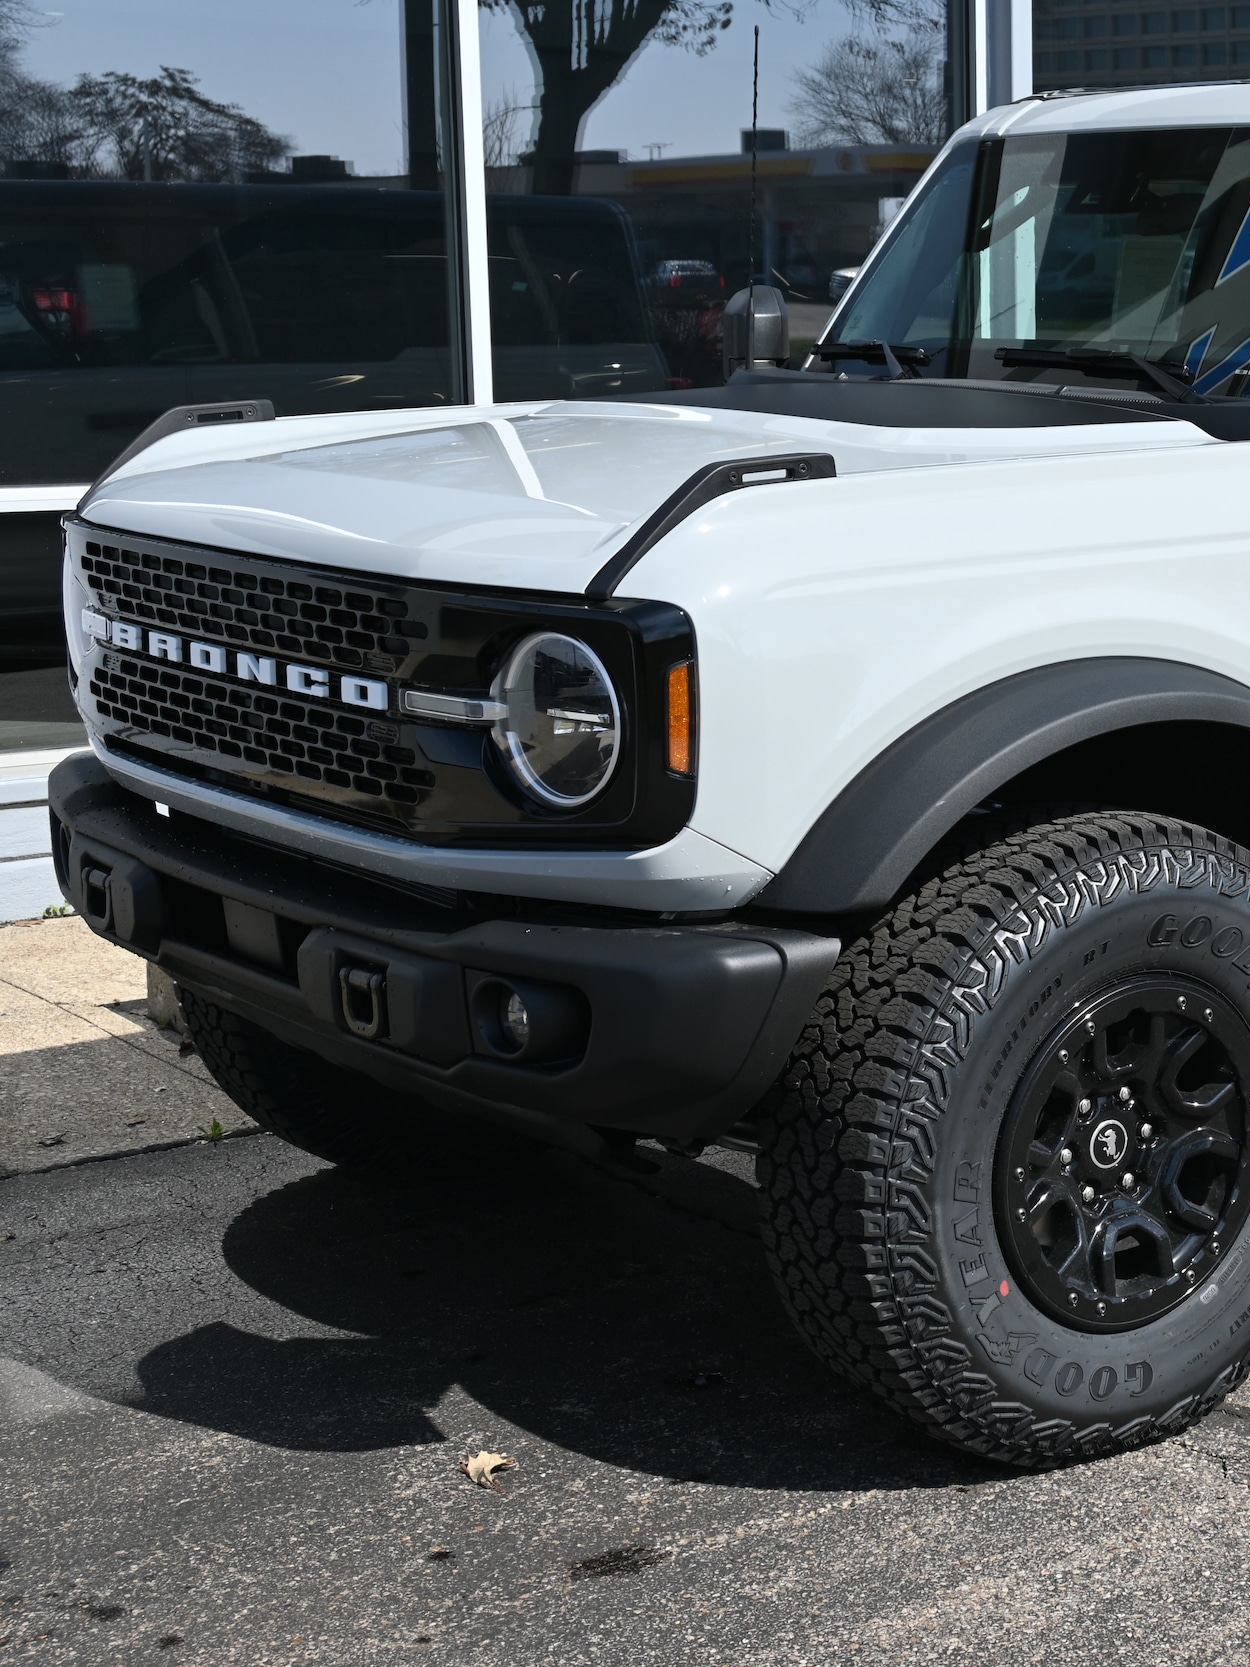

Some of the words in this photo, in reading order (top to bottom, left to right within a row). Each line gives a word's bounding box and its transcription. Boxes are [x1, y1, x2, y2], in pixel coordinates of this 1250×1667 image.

[112, 620, 389, 711] BRONCO
[978, 972, 1065, 1111] TERRITORY
[1083, 939, 1112, 967] RT
[953, 1159, 1154, 1402] GOODYEAR
